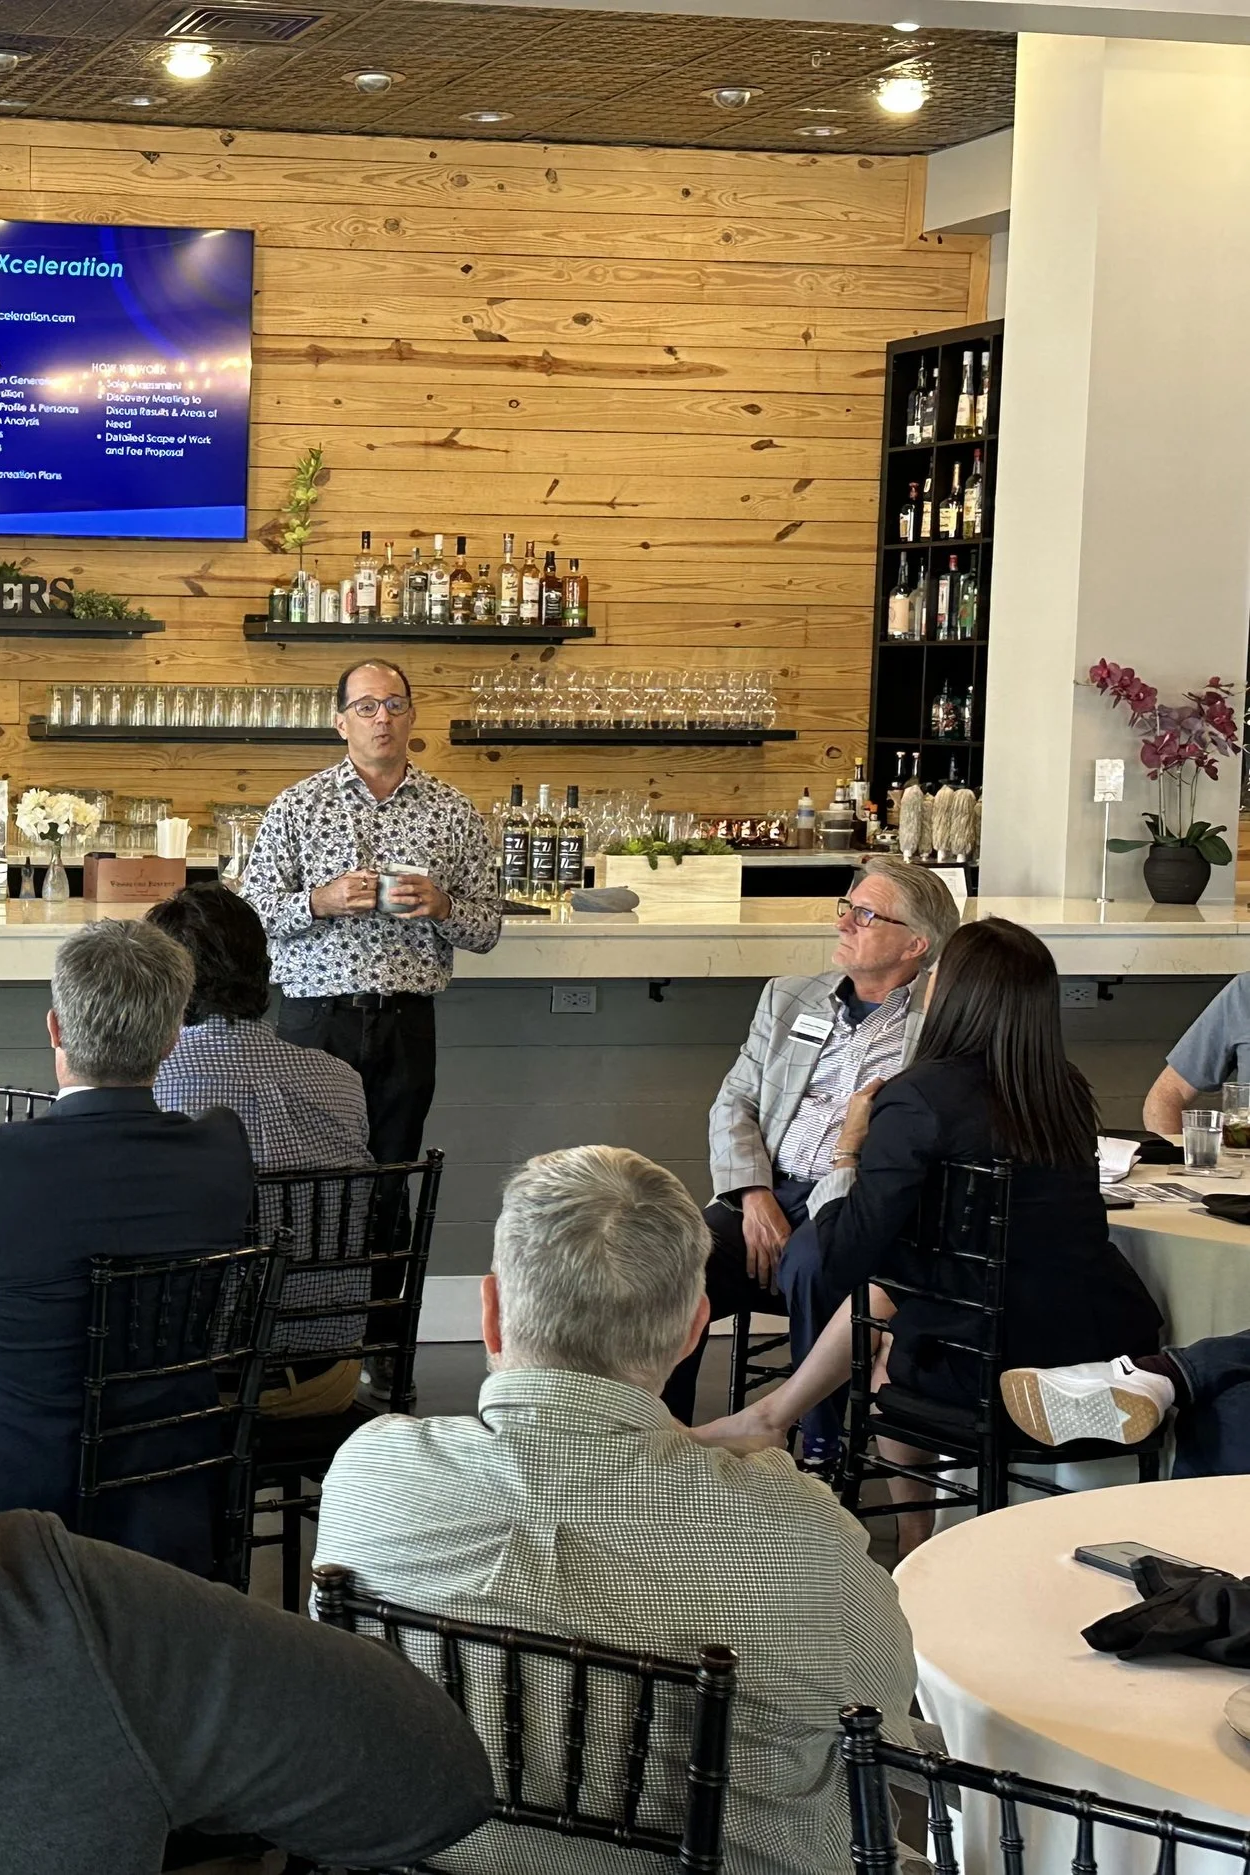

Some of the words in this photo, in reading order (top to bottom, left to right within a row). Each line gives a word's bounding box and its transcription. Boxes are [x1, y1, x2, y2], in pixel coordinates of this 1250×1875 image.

[119, 364, 136, 374] W
[106, 393, 150, 404] Discovery
[152, 394, 190, 406] Meeting
[192, 395, 201, 405] to
[0, 402, 27, 412] Profile
[30, 403, 36, 413] &
[38, 404, 79, 414] Personas
[106, 406, 138, 416] Discuss
[139, 407, 169, 417] Results
[171, 408, 178, 417] &
[180, 409, 205, 418] Areas
[207, 409, 217, 418] of
[4, 417, 39, 427] Analysis
[105, 420, 131, 429] Need
[105, 432, 144, 443] Detailed
[146, 434, 175, 445] Scope
[177, 434, 186, 444] of
[188, 435, 211, 445] Work
[105, 447, 124, 456] and
[126, 447, 143, 456] Fee
[145, 447, 184, 457] Proposal
[38, 470, 62, 480] Plans
